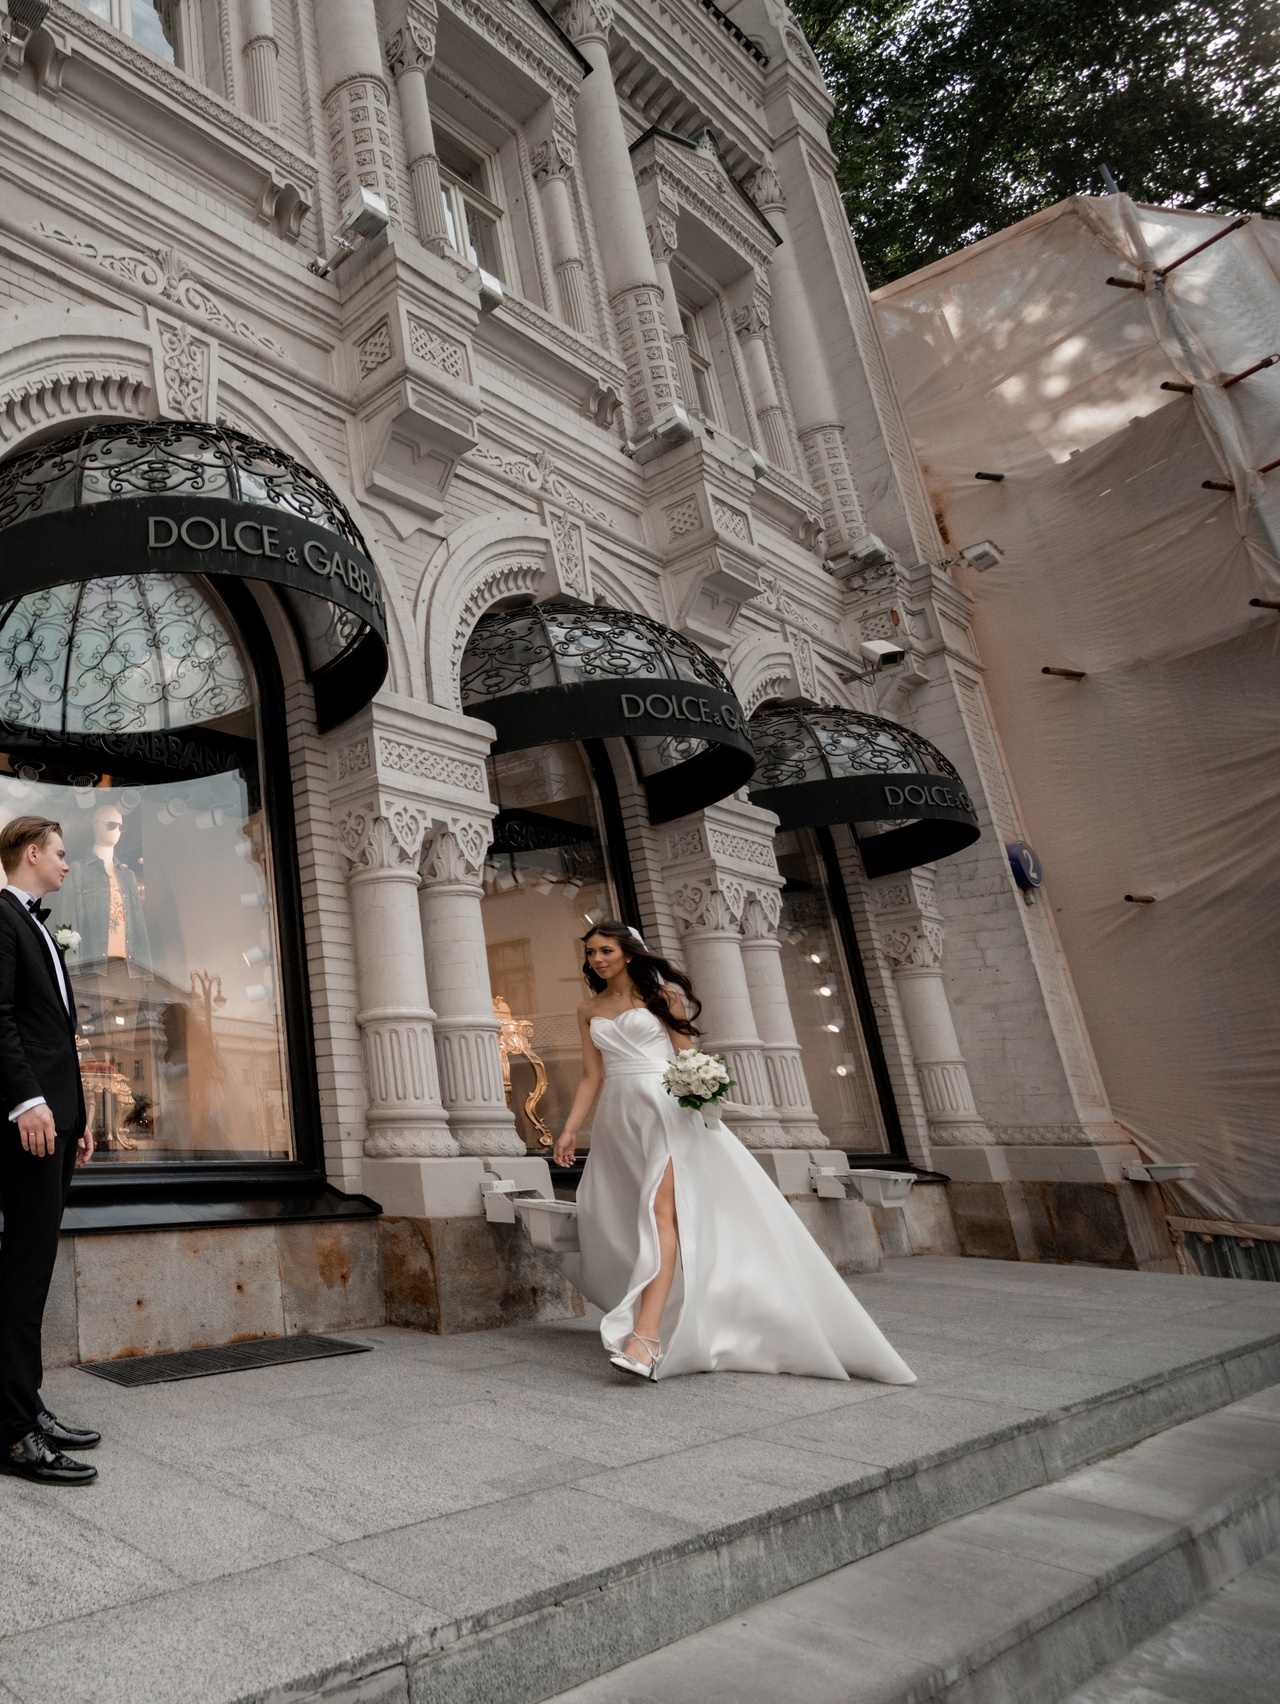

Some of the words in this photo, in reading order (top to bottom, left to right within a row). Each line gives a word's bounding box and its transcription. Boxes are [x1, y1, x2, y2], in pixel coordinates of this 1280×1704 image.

[148, 516, 281, 558] DOLCE
[285, 546, 300, 566] &
[620, 694, 713, 723] DOLCE
[884, 785, 955, 807] DOLCE
[1023, 849, 1038, 879] 2
